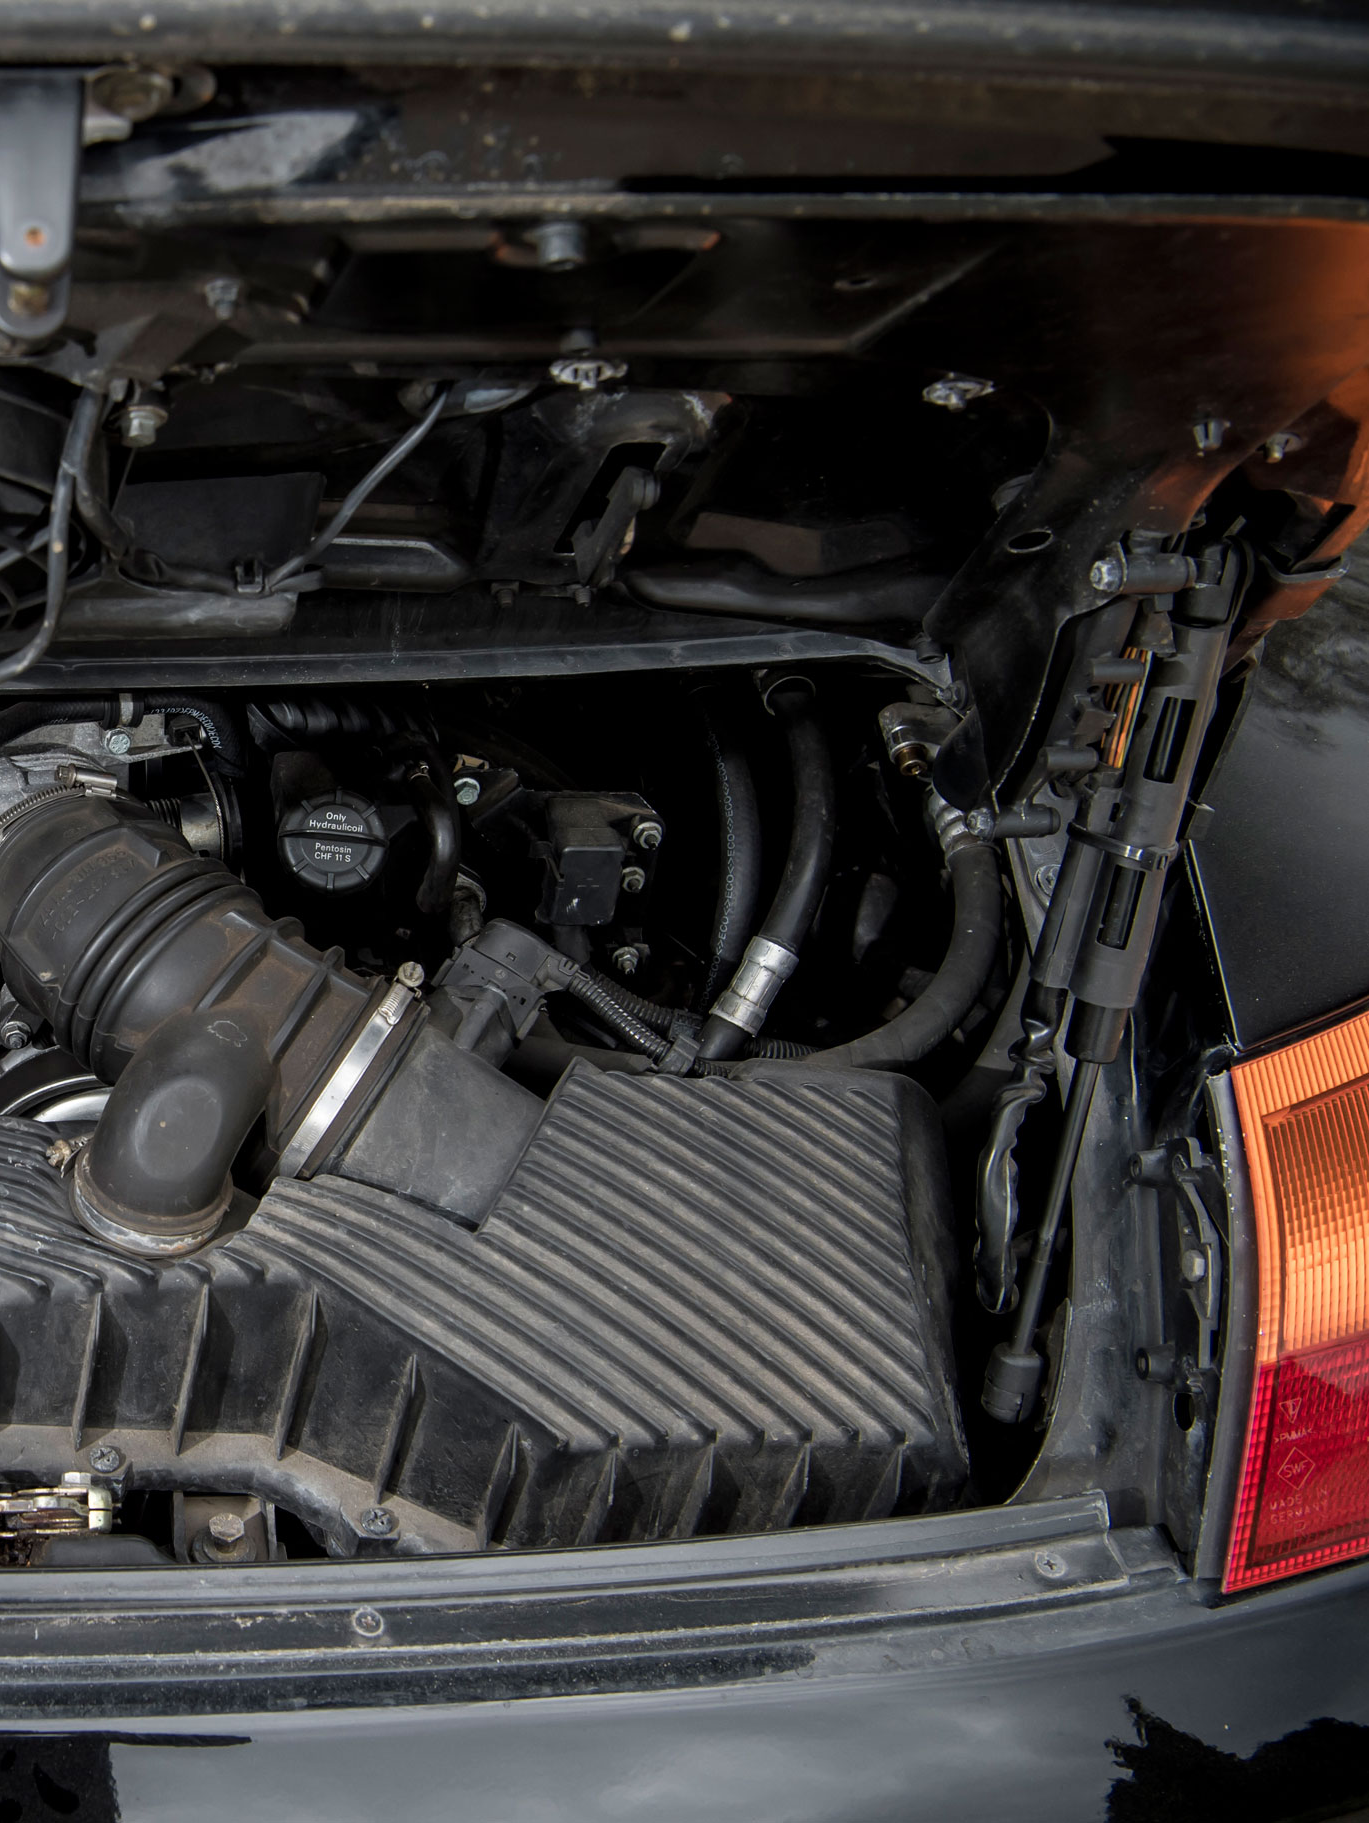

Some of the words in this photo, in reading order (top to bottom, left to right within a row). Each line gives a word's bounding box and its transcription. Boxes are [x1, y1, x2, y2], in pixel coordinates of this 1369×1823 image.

[326, 812, 347, 822] Only
[310, 820, 363, 833] Hydraulicoil
[316, 843, 352, 854] Pentosin
[315, 852, 332, 861] CHF
[335, 854, 343, 862] 11
[345, 855, 351, 863] S
[1284, 1460, 1309, 1478] SWF
[1270, 1495, 1303, 1511] MADE
[1271, 1500, 1327, 1525] GERMANY
